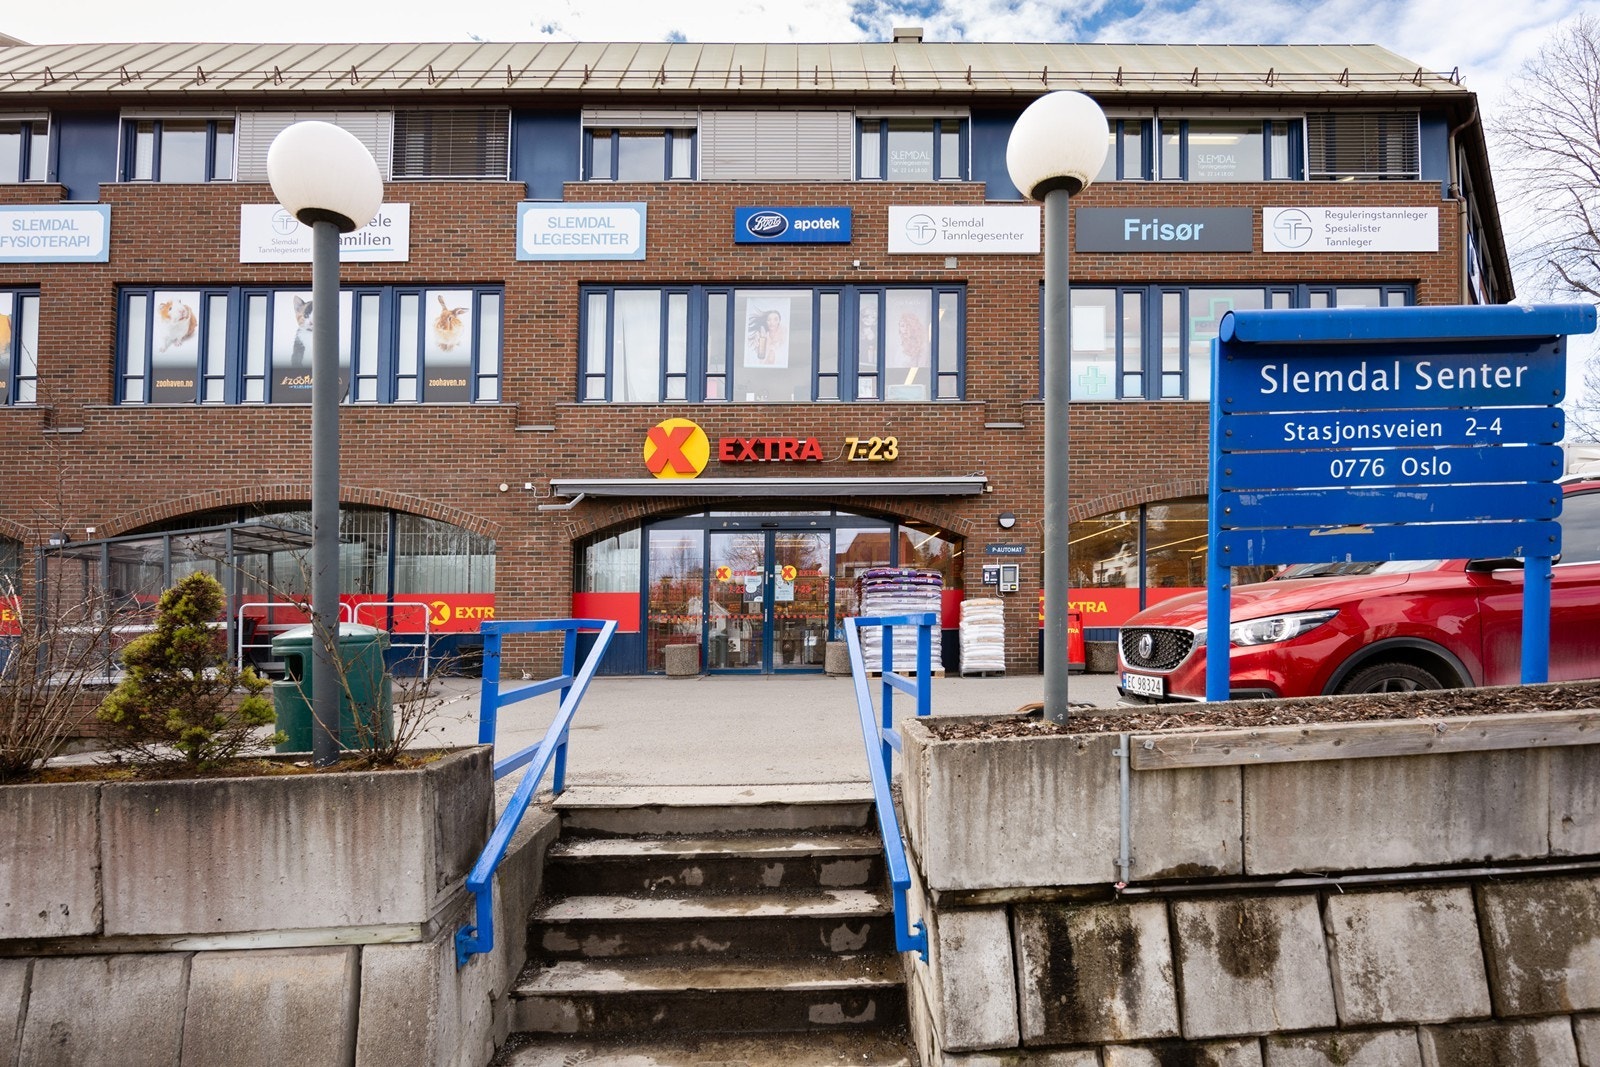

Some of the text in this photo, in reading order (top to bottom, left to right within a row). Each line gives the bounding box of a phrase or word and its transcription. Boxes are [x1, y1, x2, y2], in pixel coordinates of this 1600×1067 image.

[890, 151, 931, 160] SLEMDAL
[1198, 154, 1237, 164] SLEMDAL
[368, 213, 392, 227] ele
[1325, 209, 1428, 221] Reguleringstannleger
[12, 219, 79, 231] SLEMDAL
[547, 216, 615, 229] SLEMDAL
[751, 215, 840, 231] Boots apotek
[941, 217, 984, 228] Slemdal
[1325, 223, 1382, 234] Spesialister
[1124, 218, 1204, 241] Frisør
[0, 235, 90, 248] FYSIOTERAPI
[271, 238, 299, 246] Slemdal
[338, 232, 392, 246] amilien
[533, 233, 629, 245] LEGESENTER
[941, 230, 1024, 242] Tannlegesenter
[1325, 237, 1372, 248] Tannleger
[428, 378, 467, 387] zoohaven.no
[1260, 360, 1528, 394] Slemdal Senter
[155, 379, 193, 388] zoohaven.no
[1284, 417, 1502, 445] Stasjonsveien 2-4
[719, 437, 824, 462] EXTRA
[845, 436, 898, 462] 7-23
[1330, 456, 1452, 478] 0776 Oslo
[794, 585, 811, 593] 7-23
[455, 606, 495, 619] EXTR
[1067, 601, 1108, 612] XTRA
[1127, 675, 1135, 689] EC
[1137, 677, 1161, 693] 98324
